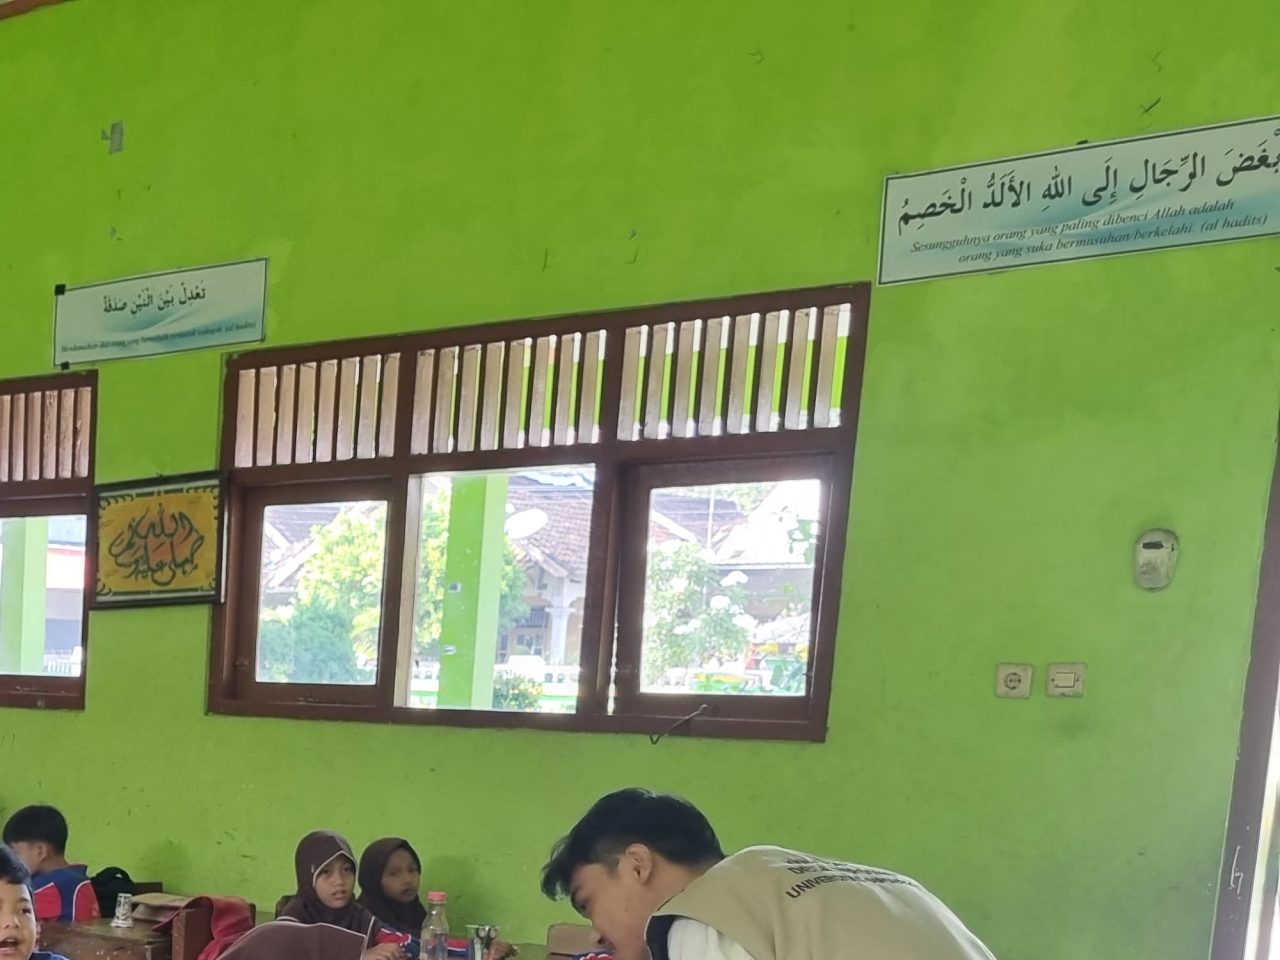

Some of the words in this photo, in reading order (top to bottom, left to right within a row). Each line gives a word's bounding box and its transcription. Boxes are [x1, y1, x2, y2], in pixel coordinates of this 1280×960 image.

[911, 234, 991, 253] Sesungguhnya
[993, 229, 1027, 241] orang
[1029, 223, 1058, 239] yang
[1060, 218, 1100, 234] paling
[1103, 209, 1148, 227] dibenci
[1151, 205, 1185, 221] Allah
[1188, 199, 1234, 215] adalah
[958, 251, 992, 264] orang
[993, 245, 1022, 261] yang
[1025, 240, 1053, 254] suka
[1200, 219, 1219, 233] (al
[1222, 213, 1268, 229] hadits)
